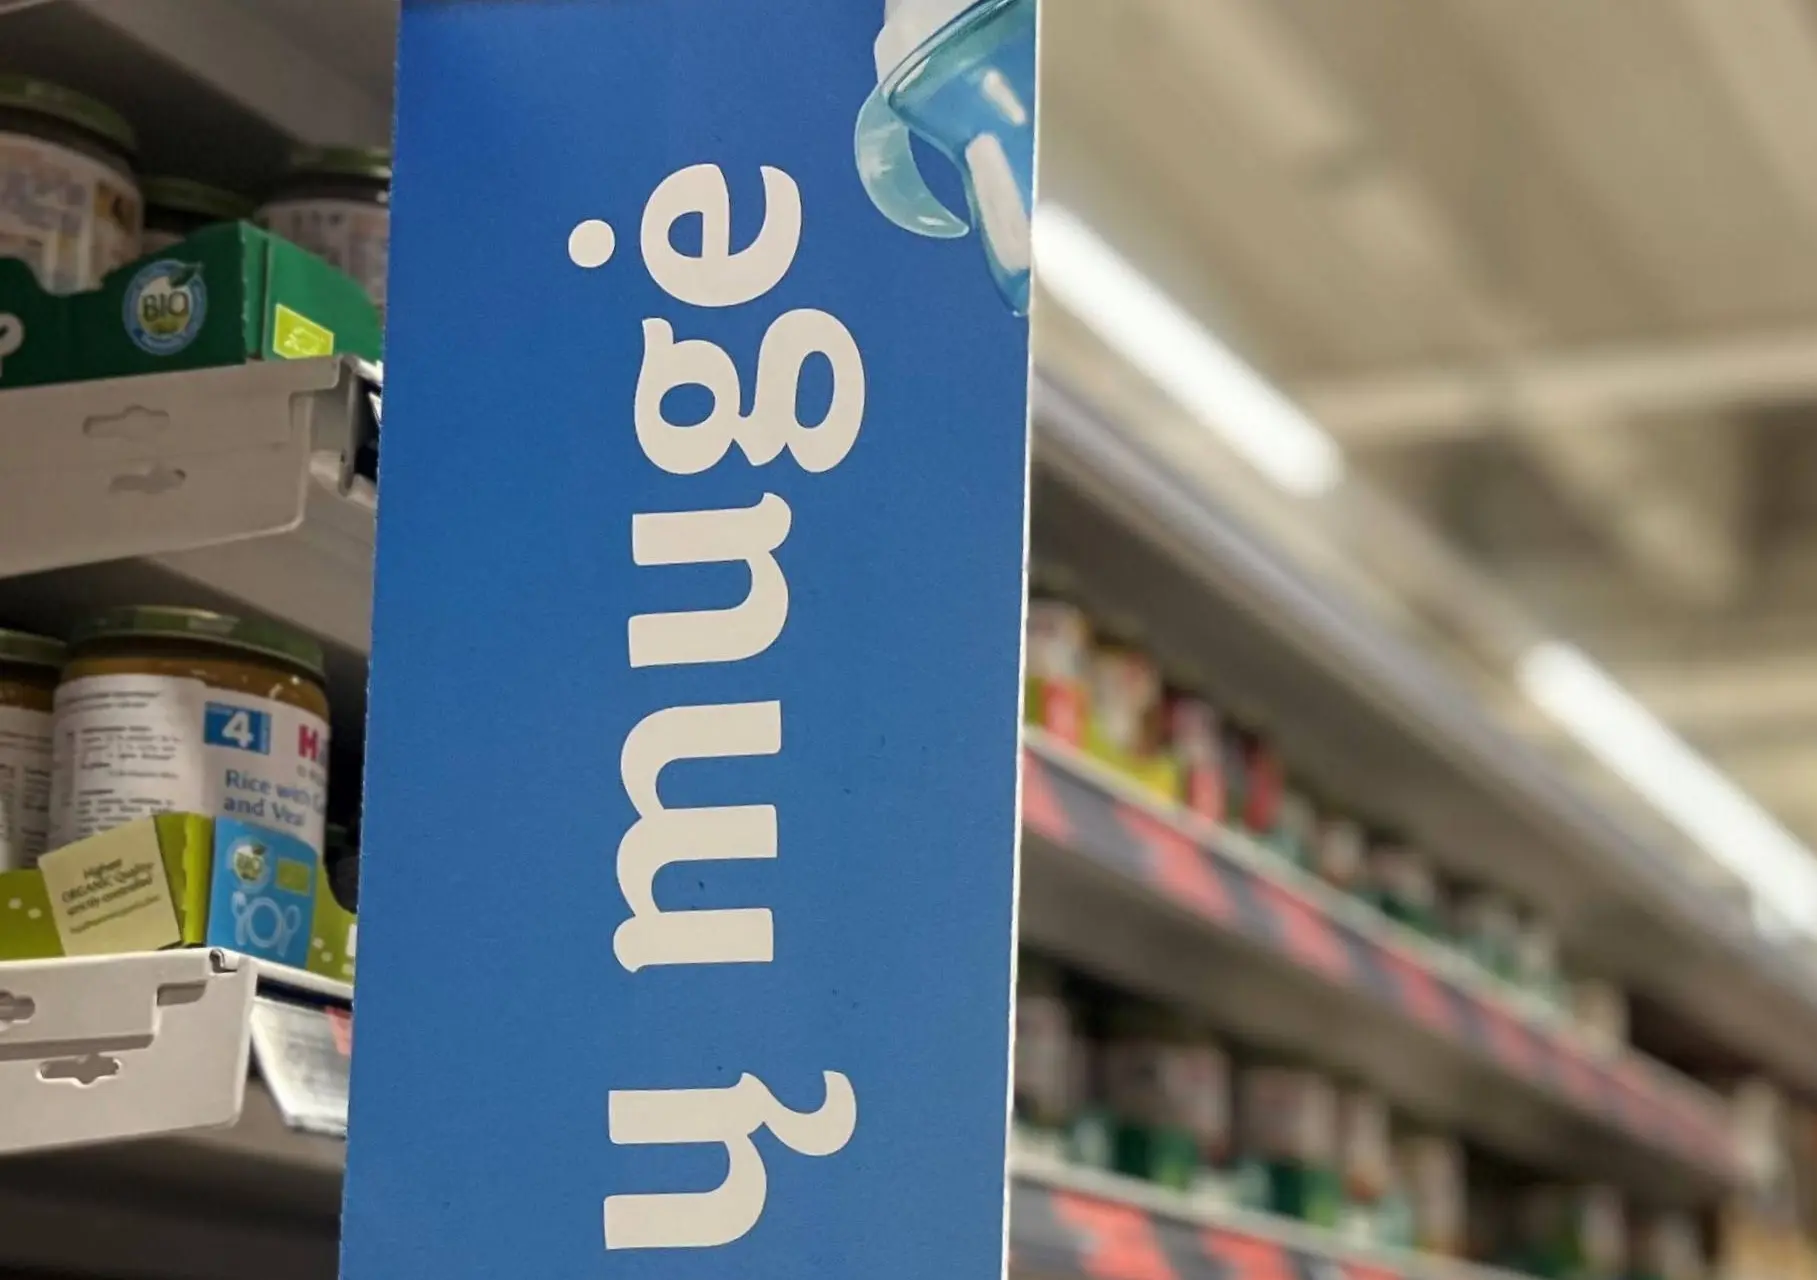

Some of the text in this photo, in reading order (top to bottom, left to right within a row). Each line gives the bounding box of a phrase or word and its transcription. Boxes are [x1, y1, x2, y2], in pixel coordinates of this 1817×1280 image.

[142, 292, 189, 322] BIO
[567, 162, 867, 974] mugė
[221, 711, 254, 748] 4
[225, 769, 271, 795] Rice
[223, 797, 265, 818] and
